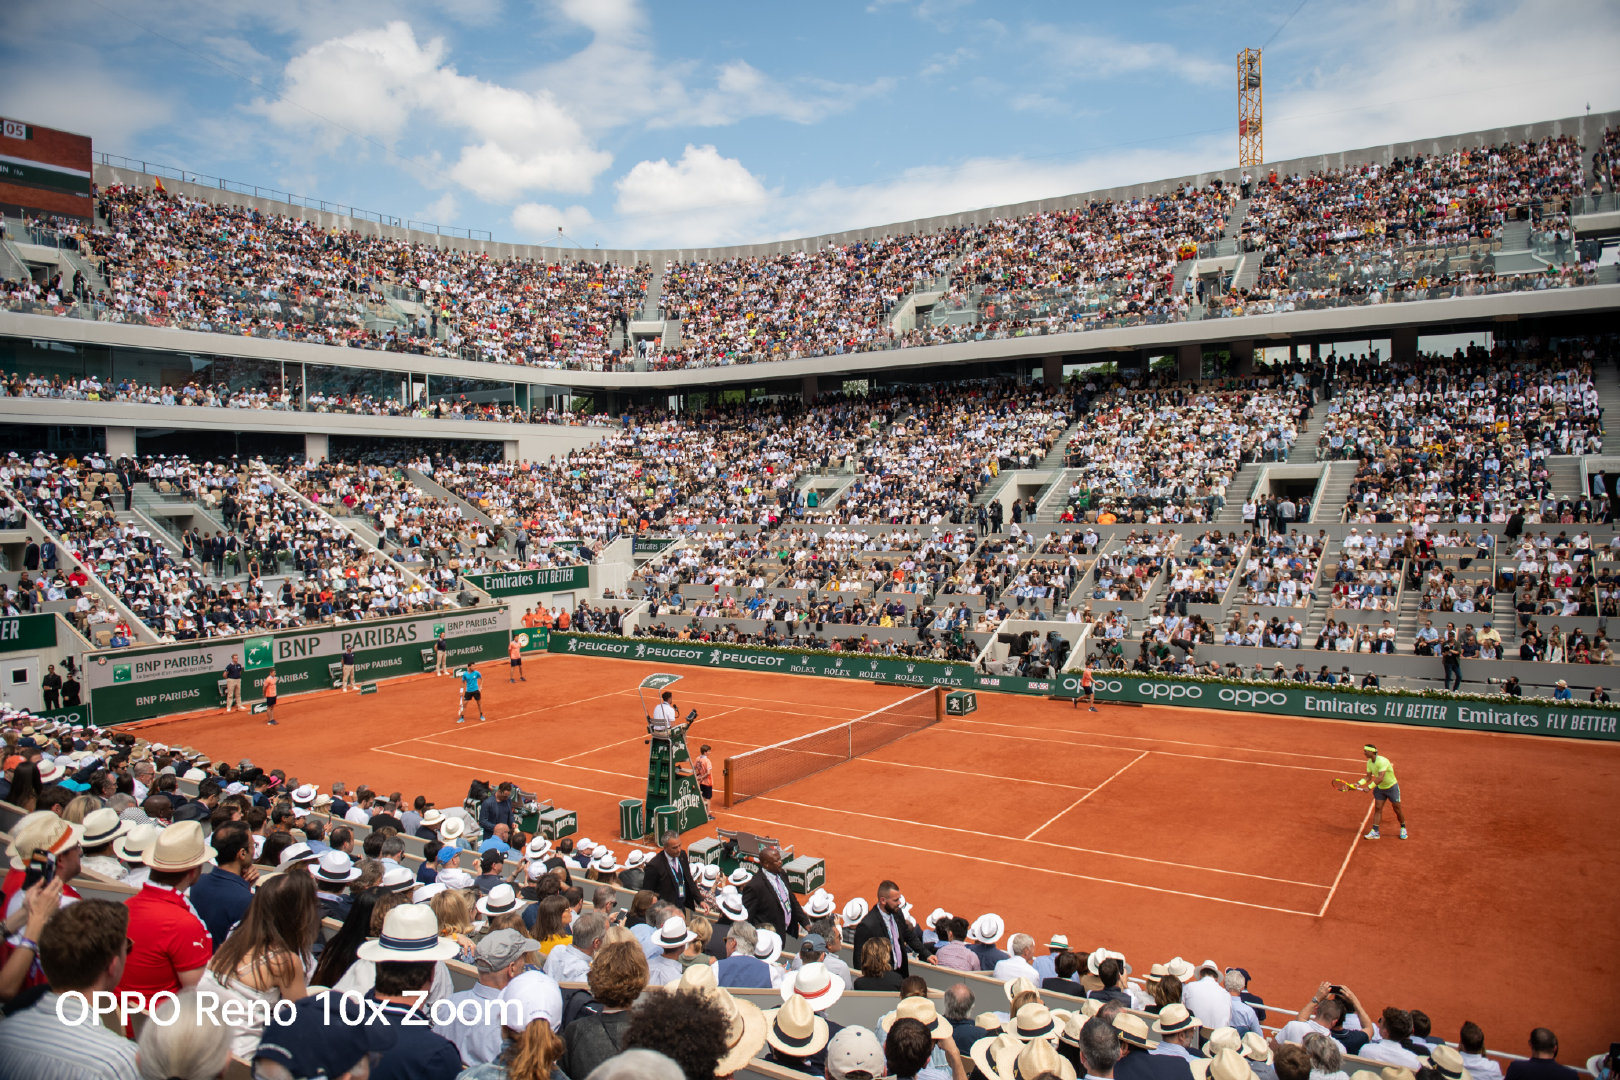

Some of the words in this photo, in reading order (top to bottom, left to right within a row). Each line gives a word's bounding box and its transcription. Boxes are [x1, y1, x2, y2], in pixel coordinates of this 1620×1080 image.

[6, 123, 23, 137] 05
[483, 574, 533, 590] Emirates
[537, 571, 549, 585] FLY
[550, 568, 574, 584] BETTER
[0, 619, 20, 640] ER
[447, 622, 464, 631] BNP
[466, 616, 497, 628] PARIBAS
[279, 637, 321, 659] BNP
[341, 623, 417, 650] PARIBAS
[578, 641, 629, 654] PEUGEOT
[457, 644, 484, 656] PARIBAS
[646, 647, 703, 659] PEUGEOT
[135, 660, 161, 673] BNP
[164, 653, 213, 669] PARIBAS
[355, 663, 370, 672] BNP
[371, 657, 402, 669] PARIBAS
[722, 653, 785, 666] PEUGEOT
[790, 665, 816, 674] ROLEX
[824, 667, 851, 677] ROLEX
[858, 670, 887, 679] ROLEX
[895, 673, 924, 683] ROLEX
[932, 677, 962, 686] ROLEX
[1063, 678, 1122, 693] oppo
[135, 695, 157, 706] BNP
[159, 688, 200, 703] PARIBAS
[1138, 682, 1203, 700] oppo
[1218, 688, 1287, 707] oppo
[1304, 696, 1377, 716] Emirates
[1384, 701, 1404, 717] FLY
[1405, 703, 1447, 721] BETTER
[46, 713, 80, 723] po
[1457, 706, 1539, 727] Emirates
[1546, 713, 1568, 729] FLY
[1571, 715, 1617, 733] BETTER
